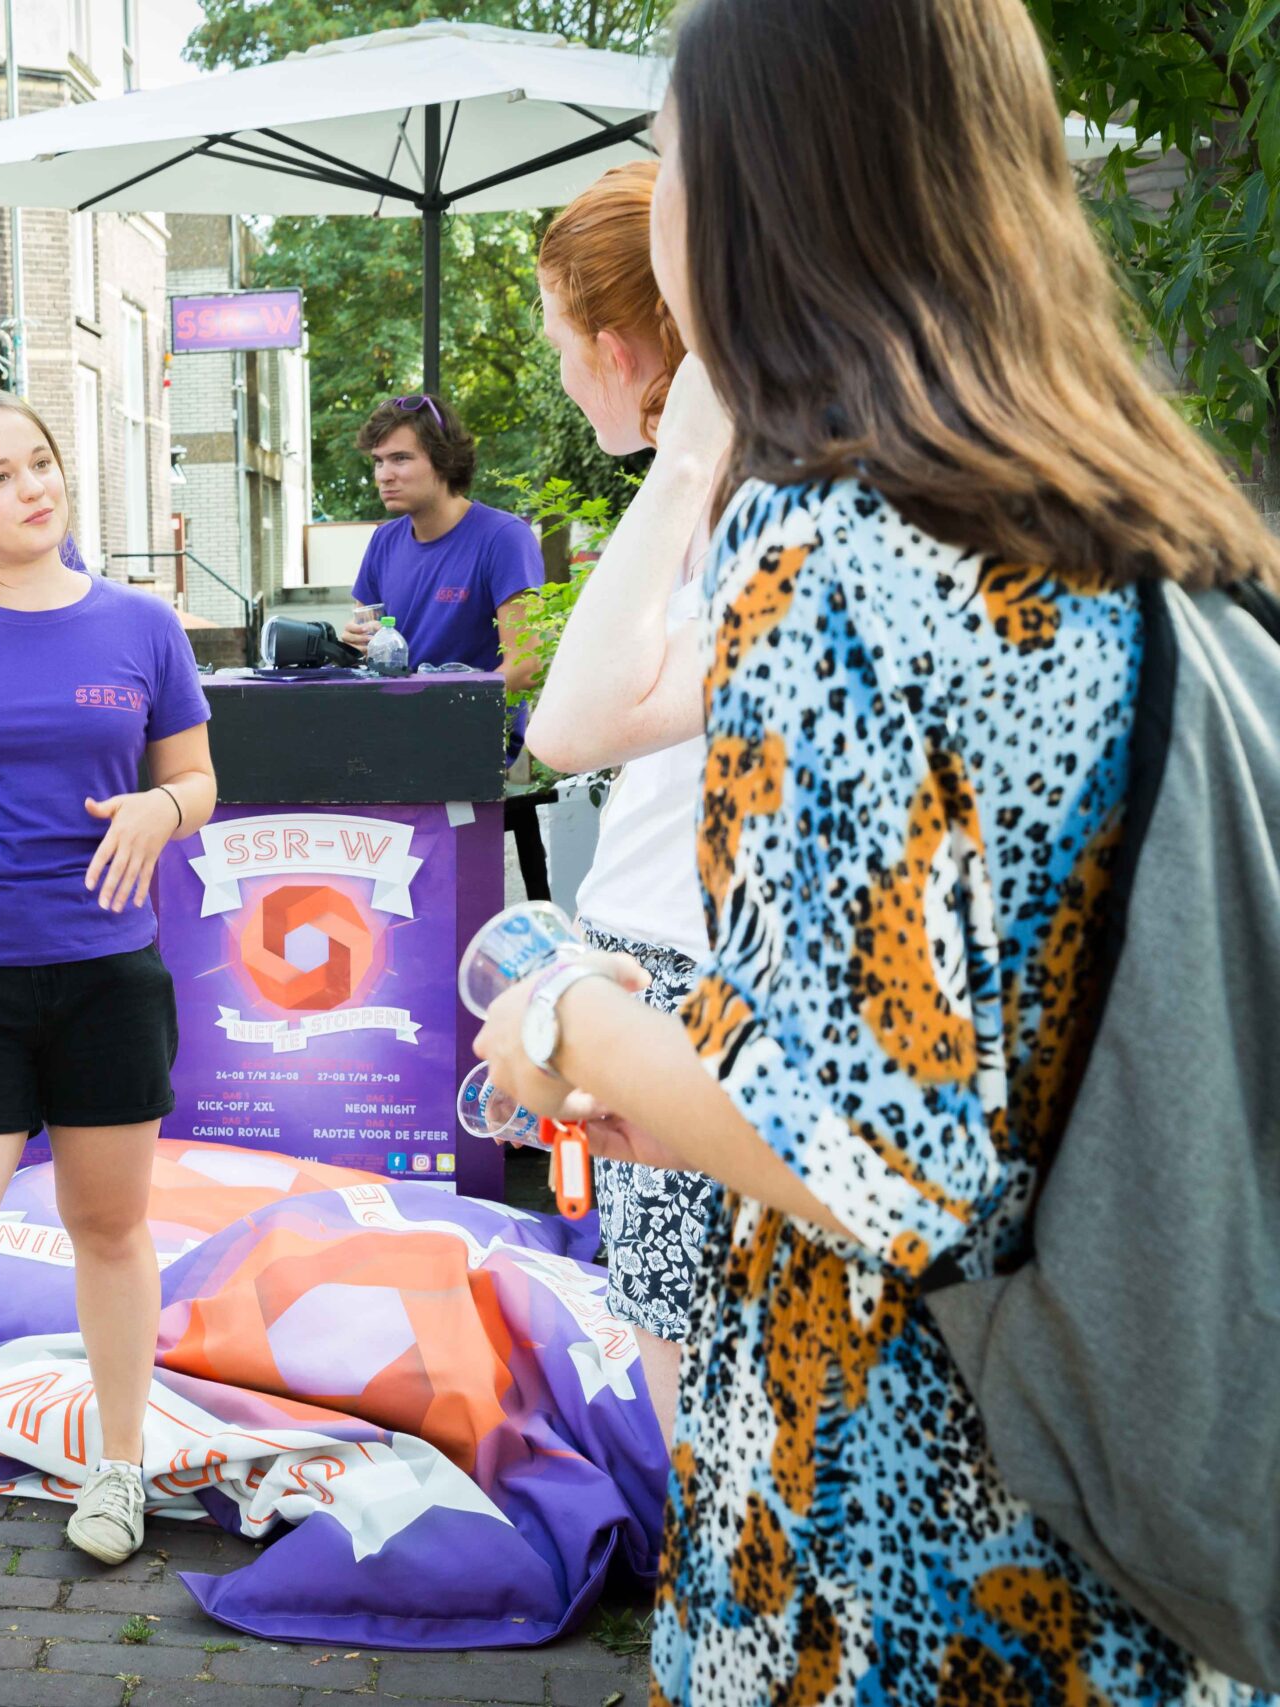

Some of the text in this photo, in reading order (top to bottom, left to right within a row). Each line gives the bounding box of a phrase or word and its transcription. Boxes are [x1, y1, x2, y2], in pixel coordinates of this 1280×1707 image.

[75, 688, 144, 710] SSR-W
[224, 828, 393, 865] SSR-W
[216, 1071, 244, 1080] 24-08
[247, 1071, 267, 1080] T/M
[270, 1072, 299, 1081] 26-08
[317, 1072, 345, 1081] 27-08
[348, 1073, 368, 1082] T/M
[371, 1074, 401, 1083] 29-08
[197, 1101, 275, 1112] KICK-OFF XXL
[345, 1103, 417, 1115] NEON NIGHT
[192, 1126, 281, 1138] CASINO ROYALE
[313, 1129, 449, 1141] RADTJE VOOR DE SFEER
